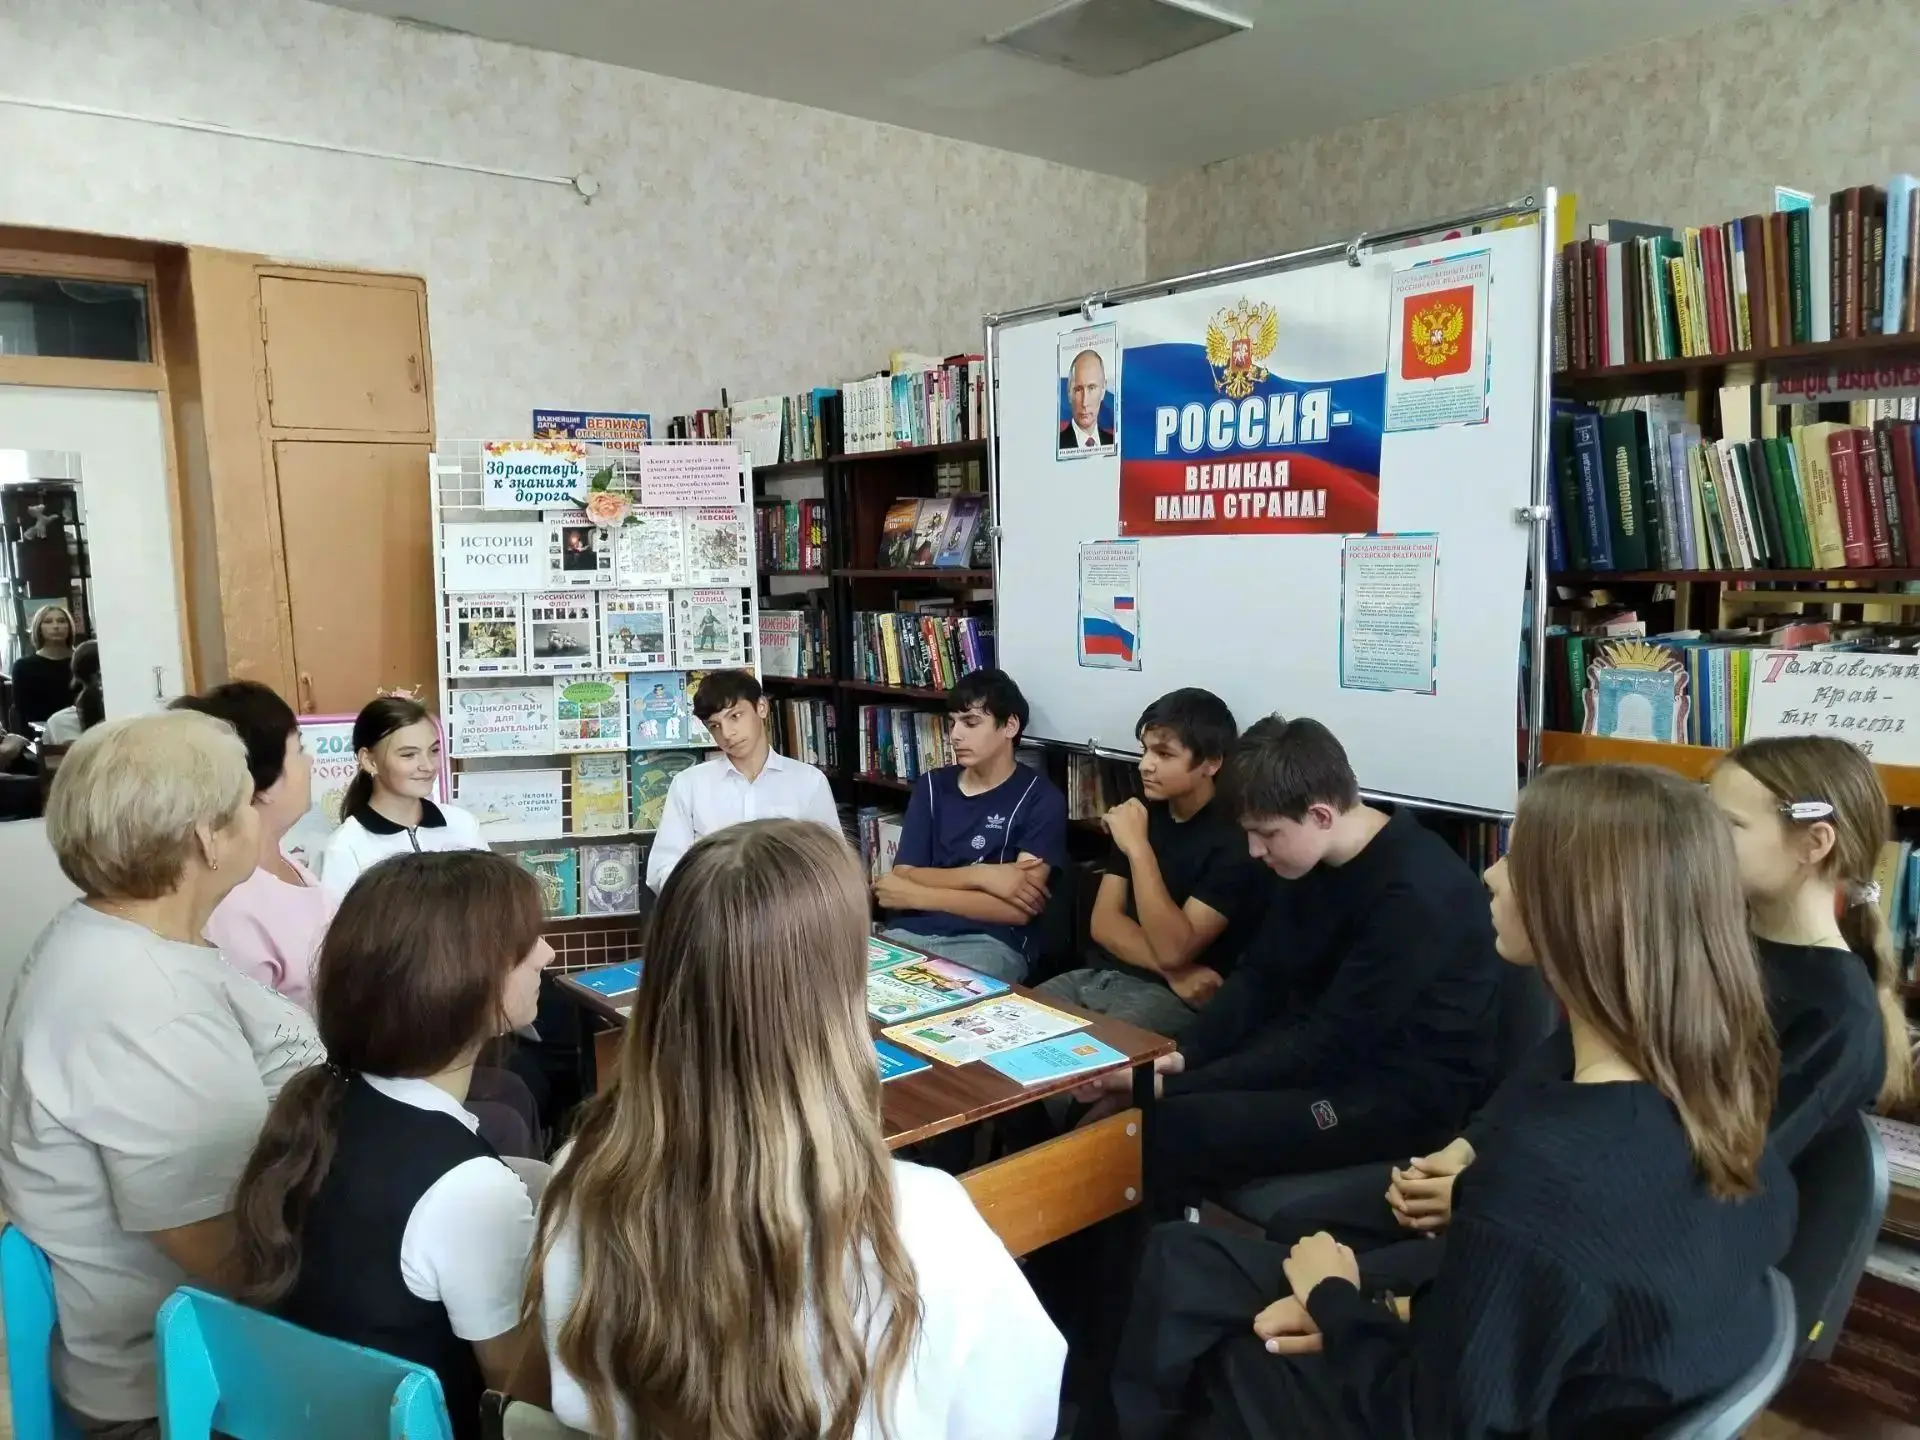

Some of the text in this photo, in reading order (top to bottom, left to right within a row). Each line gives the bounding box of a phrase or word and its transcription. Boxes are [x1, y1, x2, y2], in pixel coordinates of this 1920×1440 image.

[536, 415, 647, 429] ВАЖНЕЙШИЕ ВЕЛИКАЯ
[486, 460, 584, 479] Здравствуй,
[1184, 460, 1290, 492] ВЕЛИКАЯ
[493, 478, 578, 489] к знаниям
[515, 489, 571, 506] дорога
[1615, 446, 1635, 536] «АНТОНОВЩИНА»
[1154, 489, 1328, 522] НАША СТРАНА!
[460, 536, 534, 548] ИСТОРИЯ
[465, 553, 530, 565] РОССИИ
[533, 593, 587, 601] РОССИЙСКИЙ
[1762, 653, 1920, 683] Тамбовский
[465, 703, 543, 713] ЭНЦИКЛОПЕДИИ
[494, 715, 515, 723] ДЛЯ
[462, 724, 549, 734] ЛЮБОЗНАТЕЛЬНЫХ
